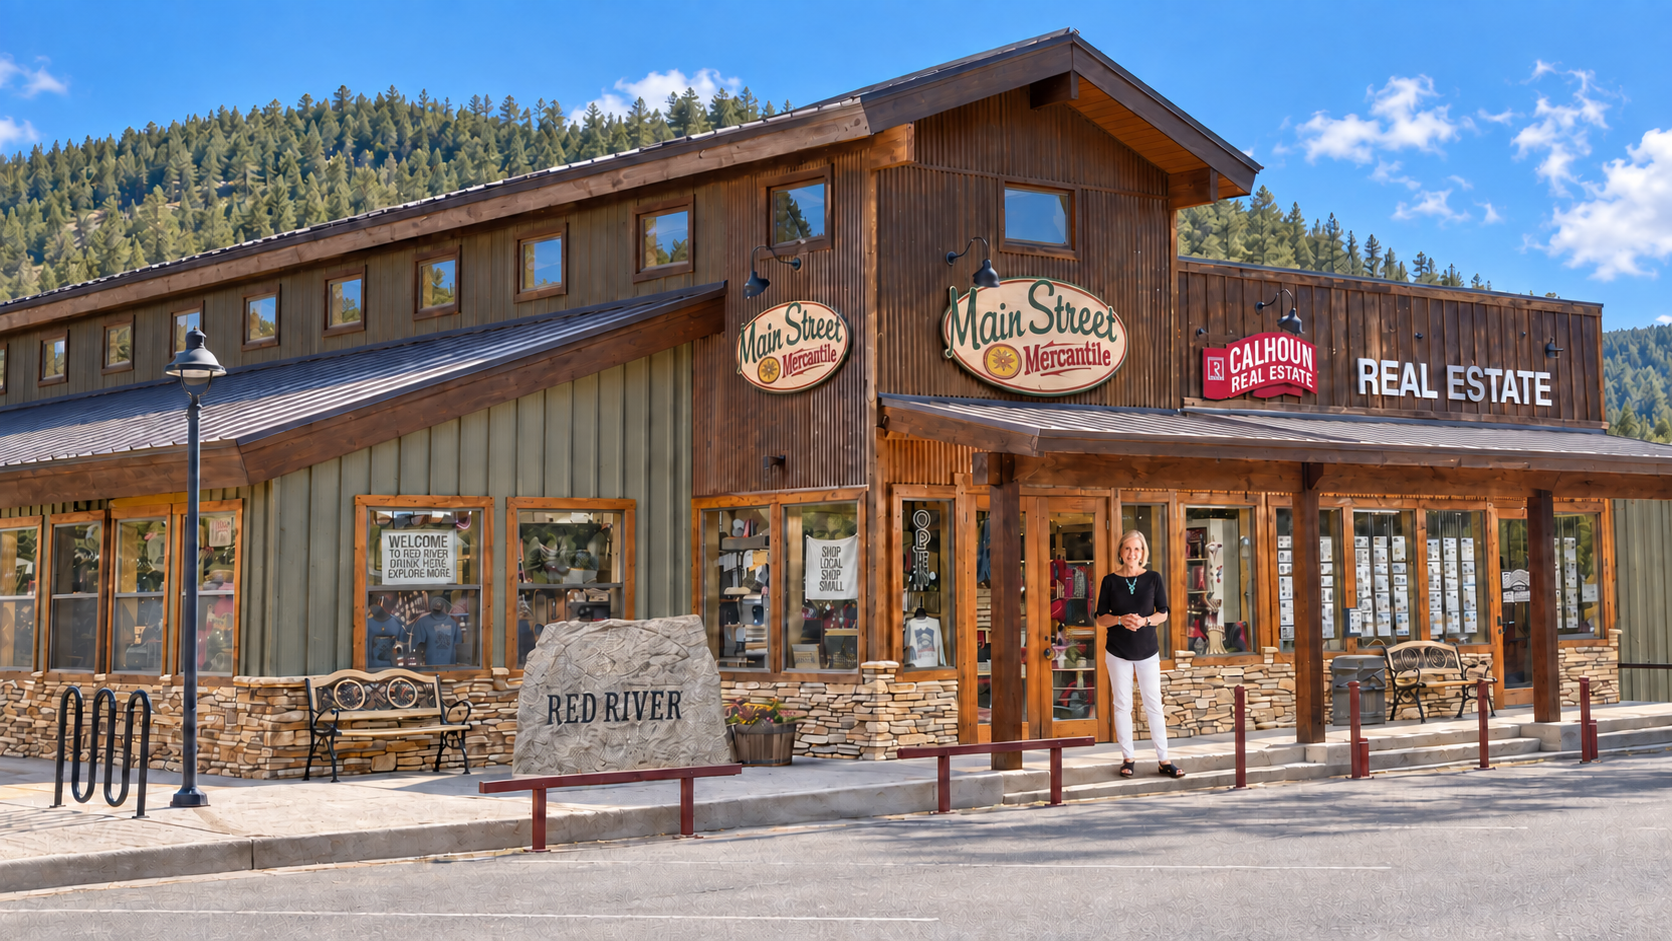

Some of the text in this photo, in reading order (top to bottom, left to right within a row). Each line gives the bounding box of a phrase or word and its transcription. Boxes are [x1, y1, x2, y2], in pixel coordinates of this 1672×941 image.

[946, 279, 1117, 357] Main Street
[737, 301, 843, 374] Main Street
[781, 343, 837, 378] Mercantile
[1023, 341, 1111, 375] Mercantile
[1229, 336, 1313, 374] CALHOUN
[1231, 364, 1313, 393] REAL ESTATE
[1357, 357, 1552, 406] REAL ESTATE
[388, 534, 448, 548] WELCOME
[389, 549, 448, 558] TO RED RIVER
[821, 545, 842, 558] SHOP
[388, 569, 451, 578] EXPLORE MORE
[820, 557, 843, 569] LOCAL
[821, 569, 842, 581] SHOP
[819, 580, 844, 592] SMALL
[546, 690, 683, 726] RED RIVER
